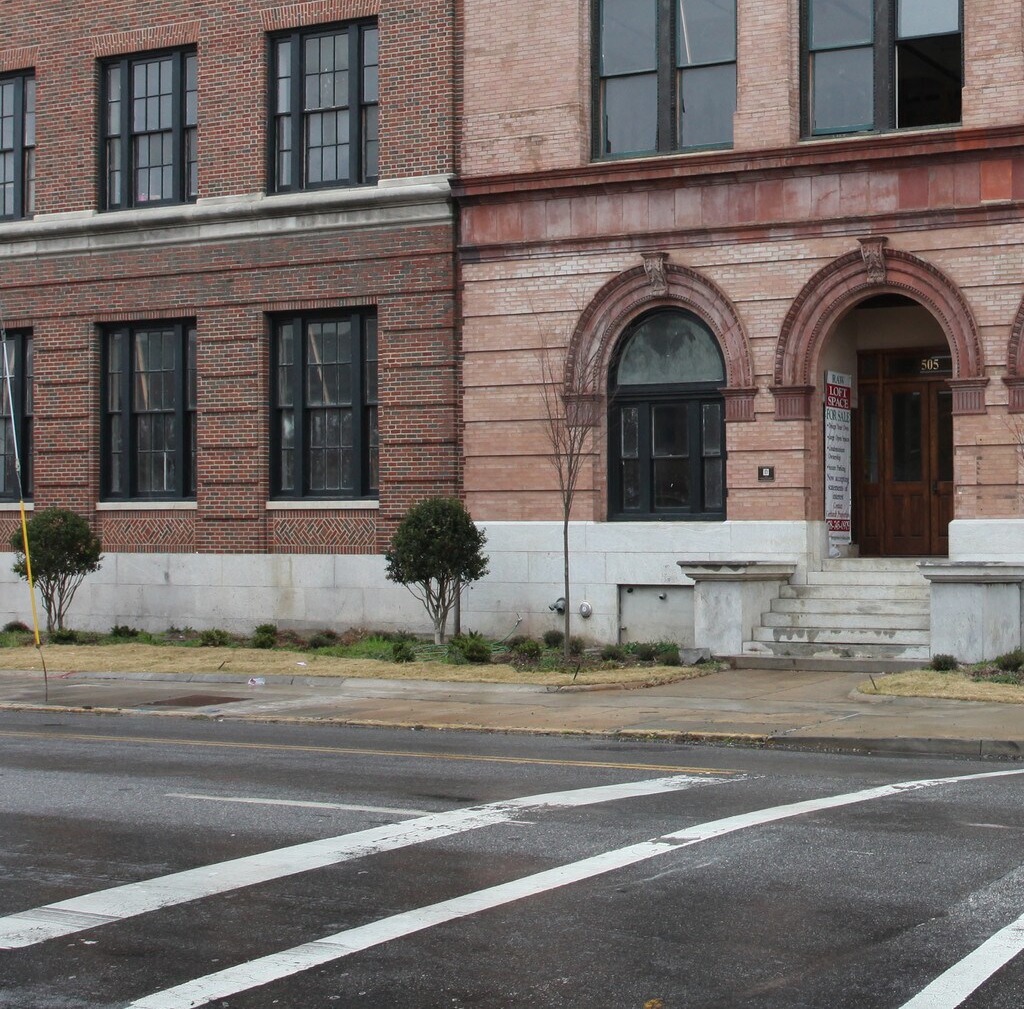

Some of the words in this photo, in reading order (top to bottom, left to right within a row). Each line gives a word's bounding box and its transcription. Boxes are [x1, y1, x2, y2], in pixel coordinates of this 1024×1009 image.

[921, 358, 940, 370] 505
[831, 374, 846, 385] RAW
[829, 385, 848, 398] LOFT
[827, 396, 849, 409] SPACE
[826, 409, 837, 421] FOR
[837, 410, 851, 423] SALE
